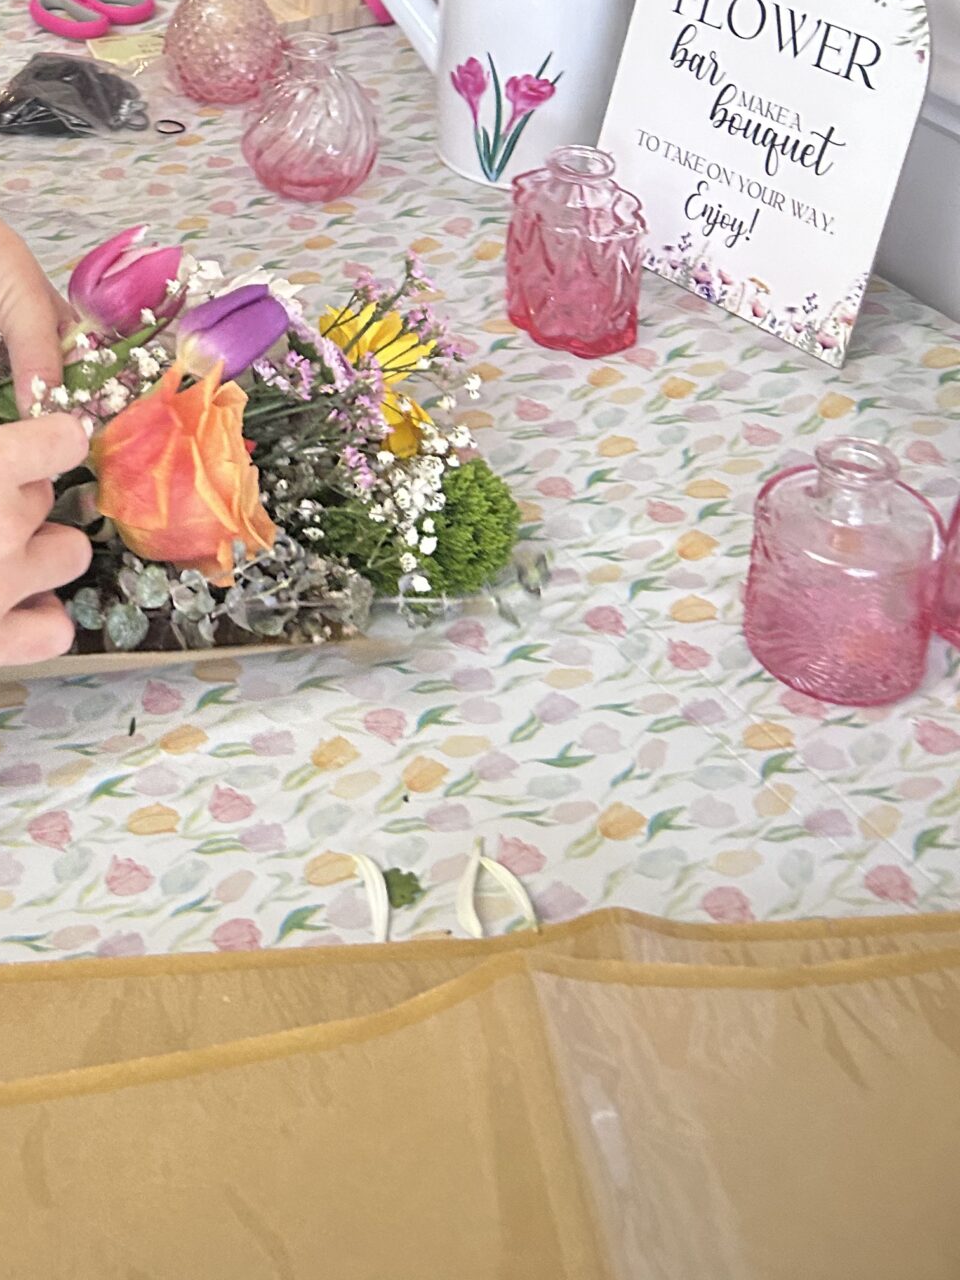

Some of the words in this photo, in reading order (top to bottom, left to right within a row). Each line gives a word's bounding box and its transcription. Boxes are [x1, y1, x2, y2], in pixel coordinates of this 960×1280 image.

[670, 24, 726, 85] bar
[709, 83, 846, 176] bouquet
[737, 92, 790, 125] MAKE
[789, 113, 802, 132] A
[636, 129, 660, 152] TO
[663, 141, 707, 175] TAKE
[707, 163, 735, 186] ON
[737, 175, 785, 212] YOUR
[790, 201, 835, 235] WAY.
[684, 180, 760, 247] Enjoy!
